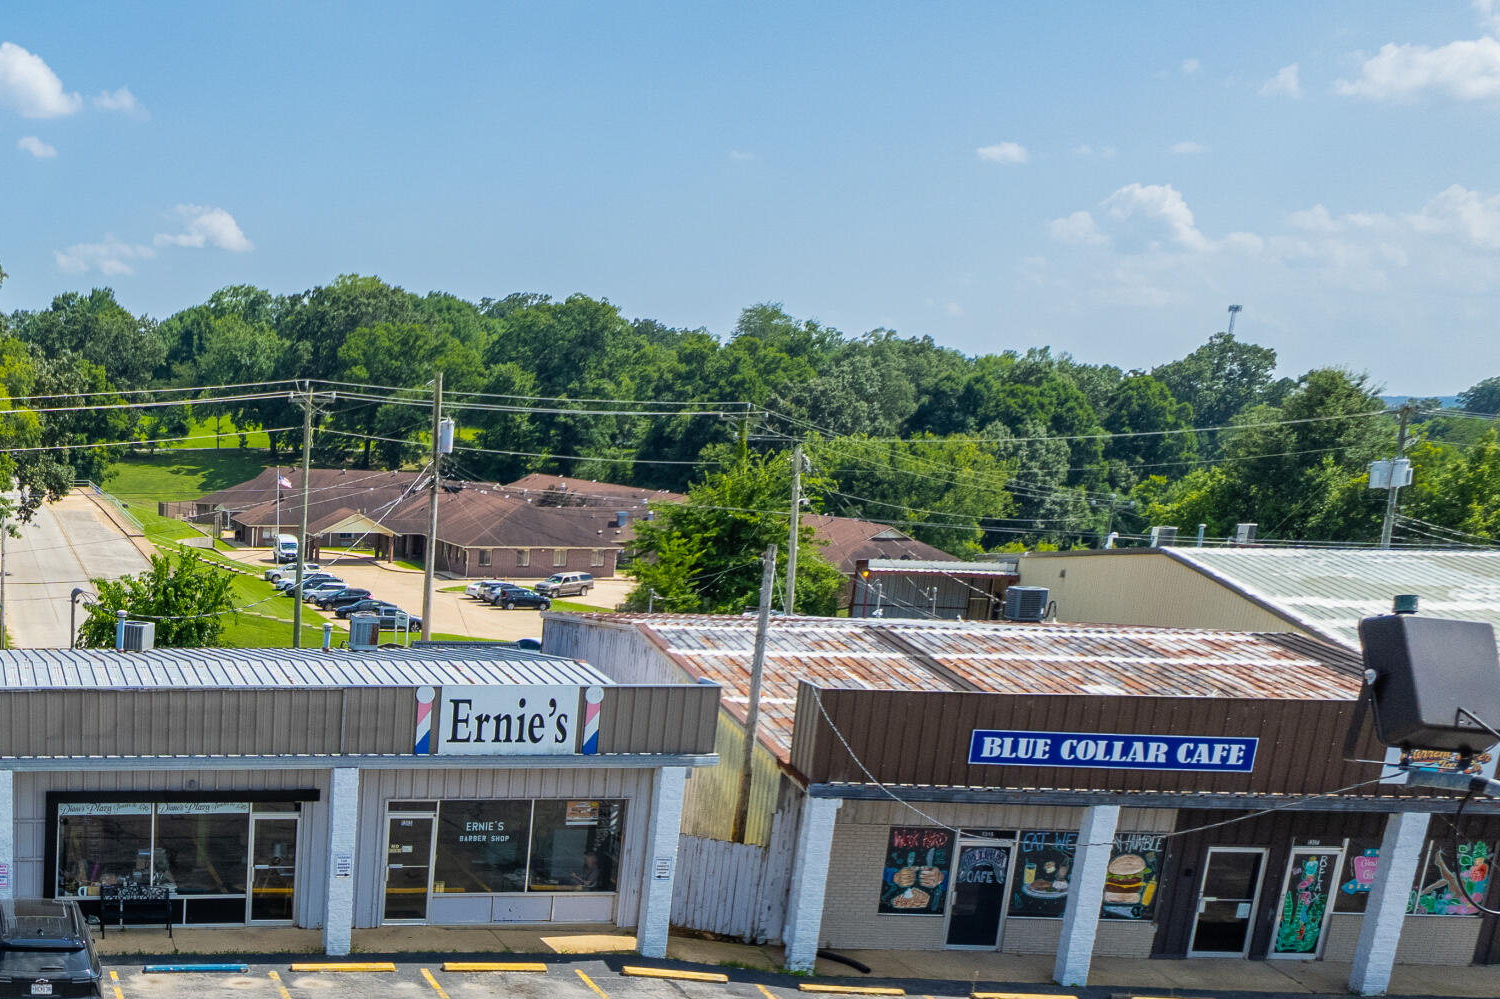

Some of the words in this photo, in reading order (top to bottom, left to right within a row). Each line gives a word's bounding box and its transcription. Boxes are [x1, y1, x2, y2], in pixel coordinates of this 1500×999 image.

[446, 698, 568, 744] Ernie's
[980, 737, 1051, 760] BLUE
[1060, 739, 1168, 763] COLLAR
[1176, 743, 1246, 765] CAFE
[466, 820, 505, 831] ERNIE'S
